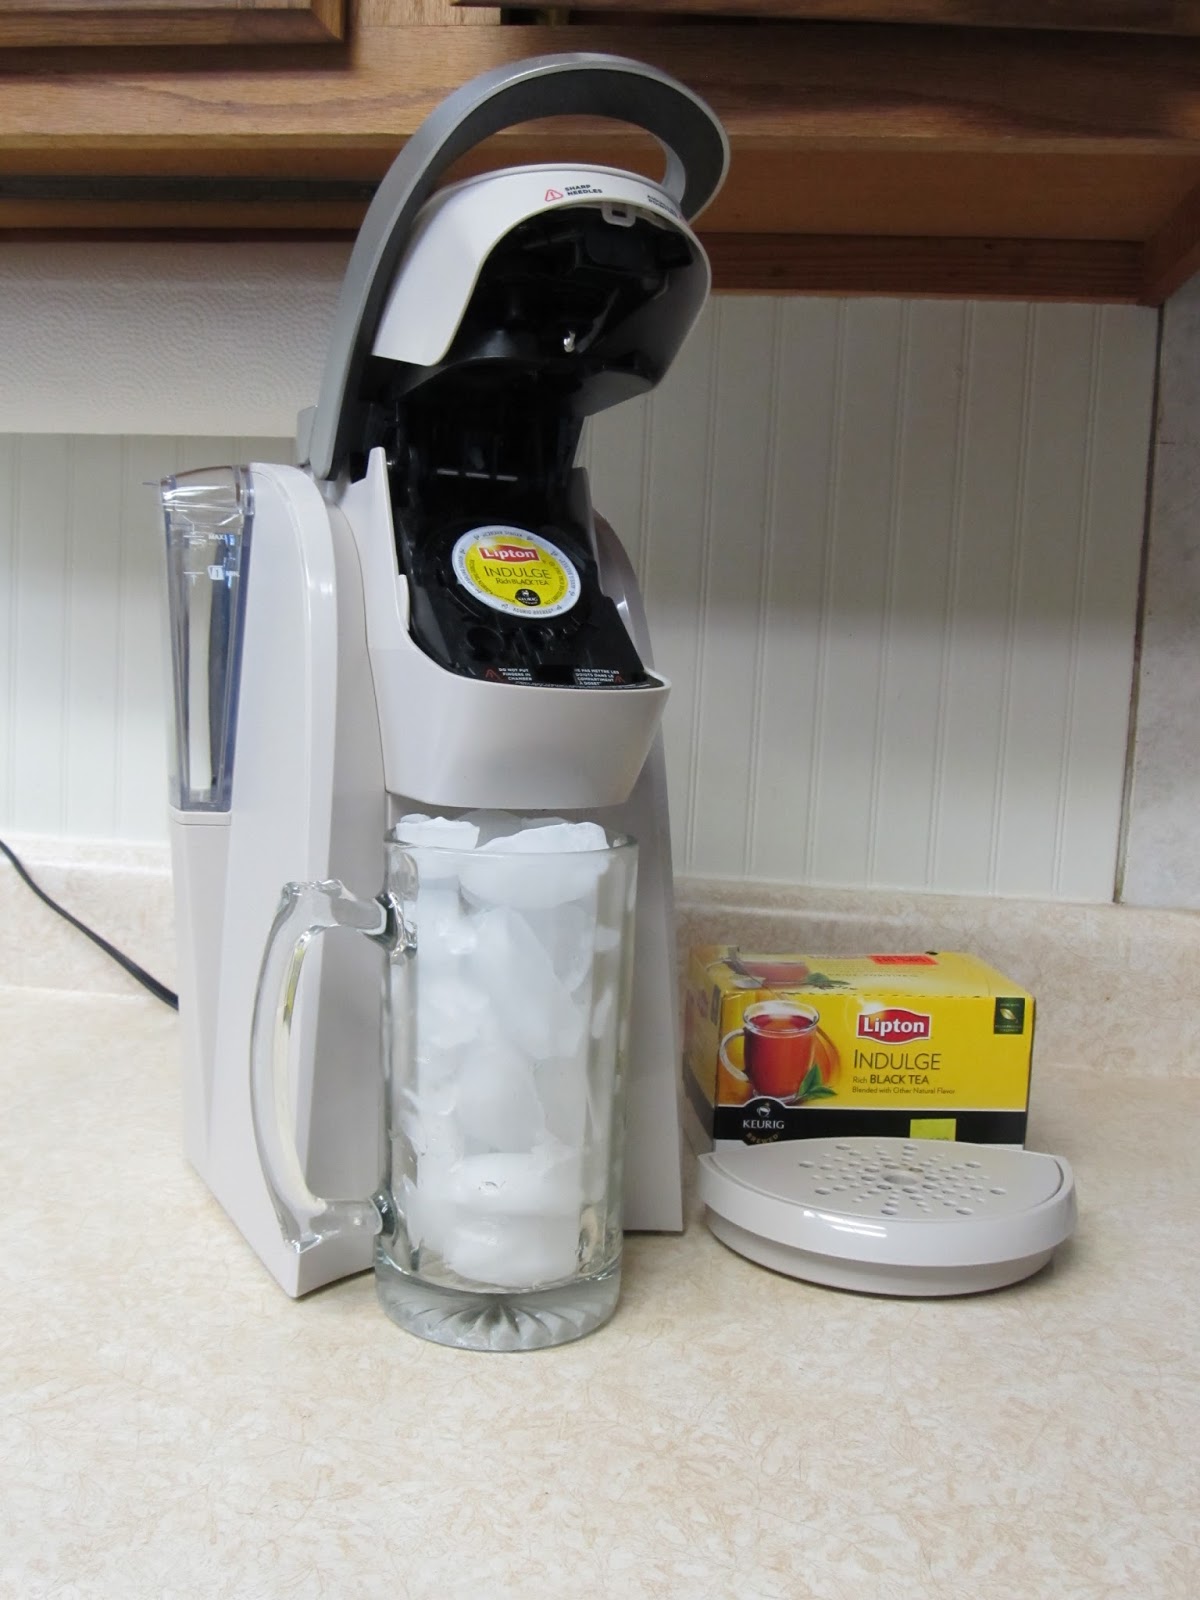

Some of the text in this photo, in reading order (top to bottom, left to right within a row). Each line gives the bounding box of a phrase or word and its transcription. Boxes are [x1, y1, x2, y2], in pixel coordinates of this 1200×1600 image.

[484, 549, 535, 560] Lipton
[484, 566, 552, 579] INDULGE
[863, 1017, 925, 1037] Lipton
[853, 1048, 942, 1071] INDULGE
[852, 1074, 930, 1085] Rich BLACK TEA
[852, 1086, 878, 1094] Blended
[893, 1087, 912, 1095] Other
[913, 1087, 936, 1095] Natural
[937, 1087, 956, 1095] Flavor
[742, 1119, 785, 1130] KEURIG
